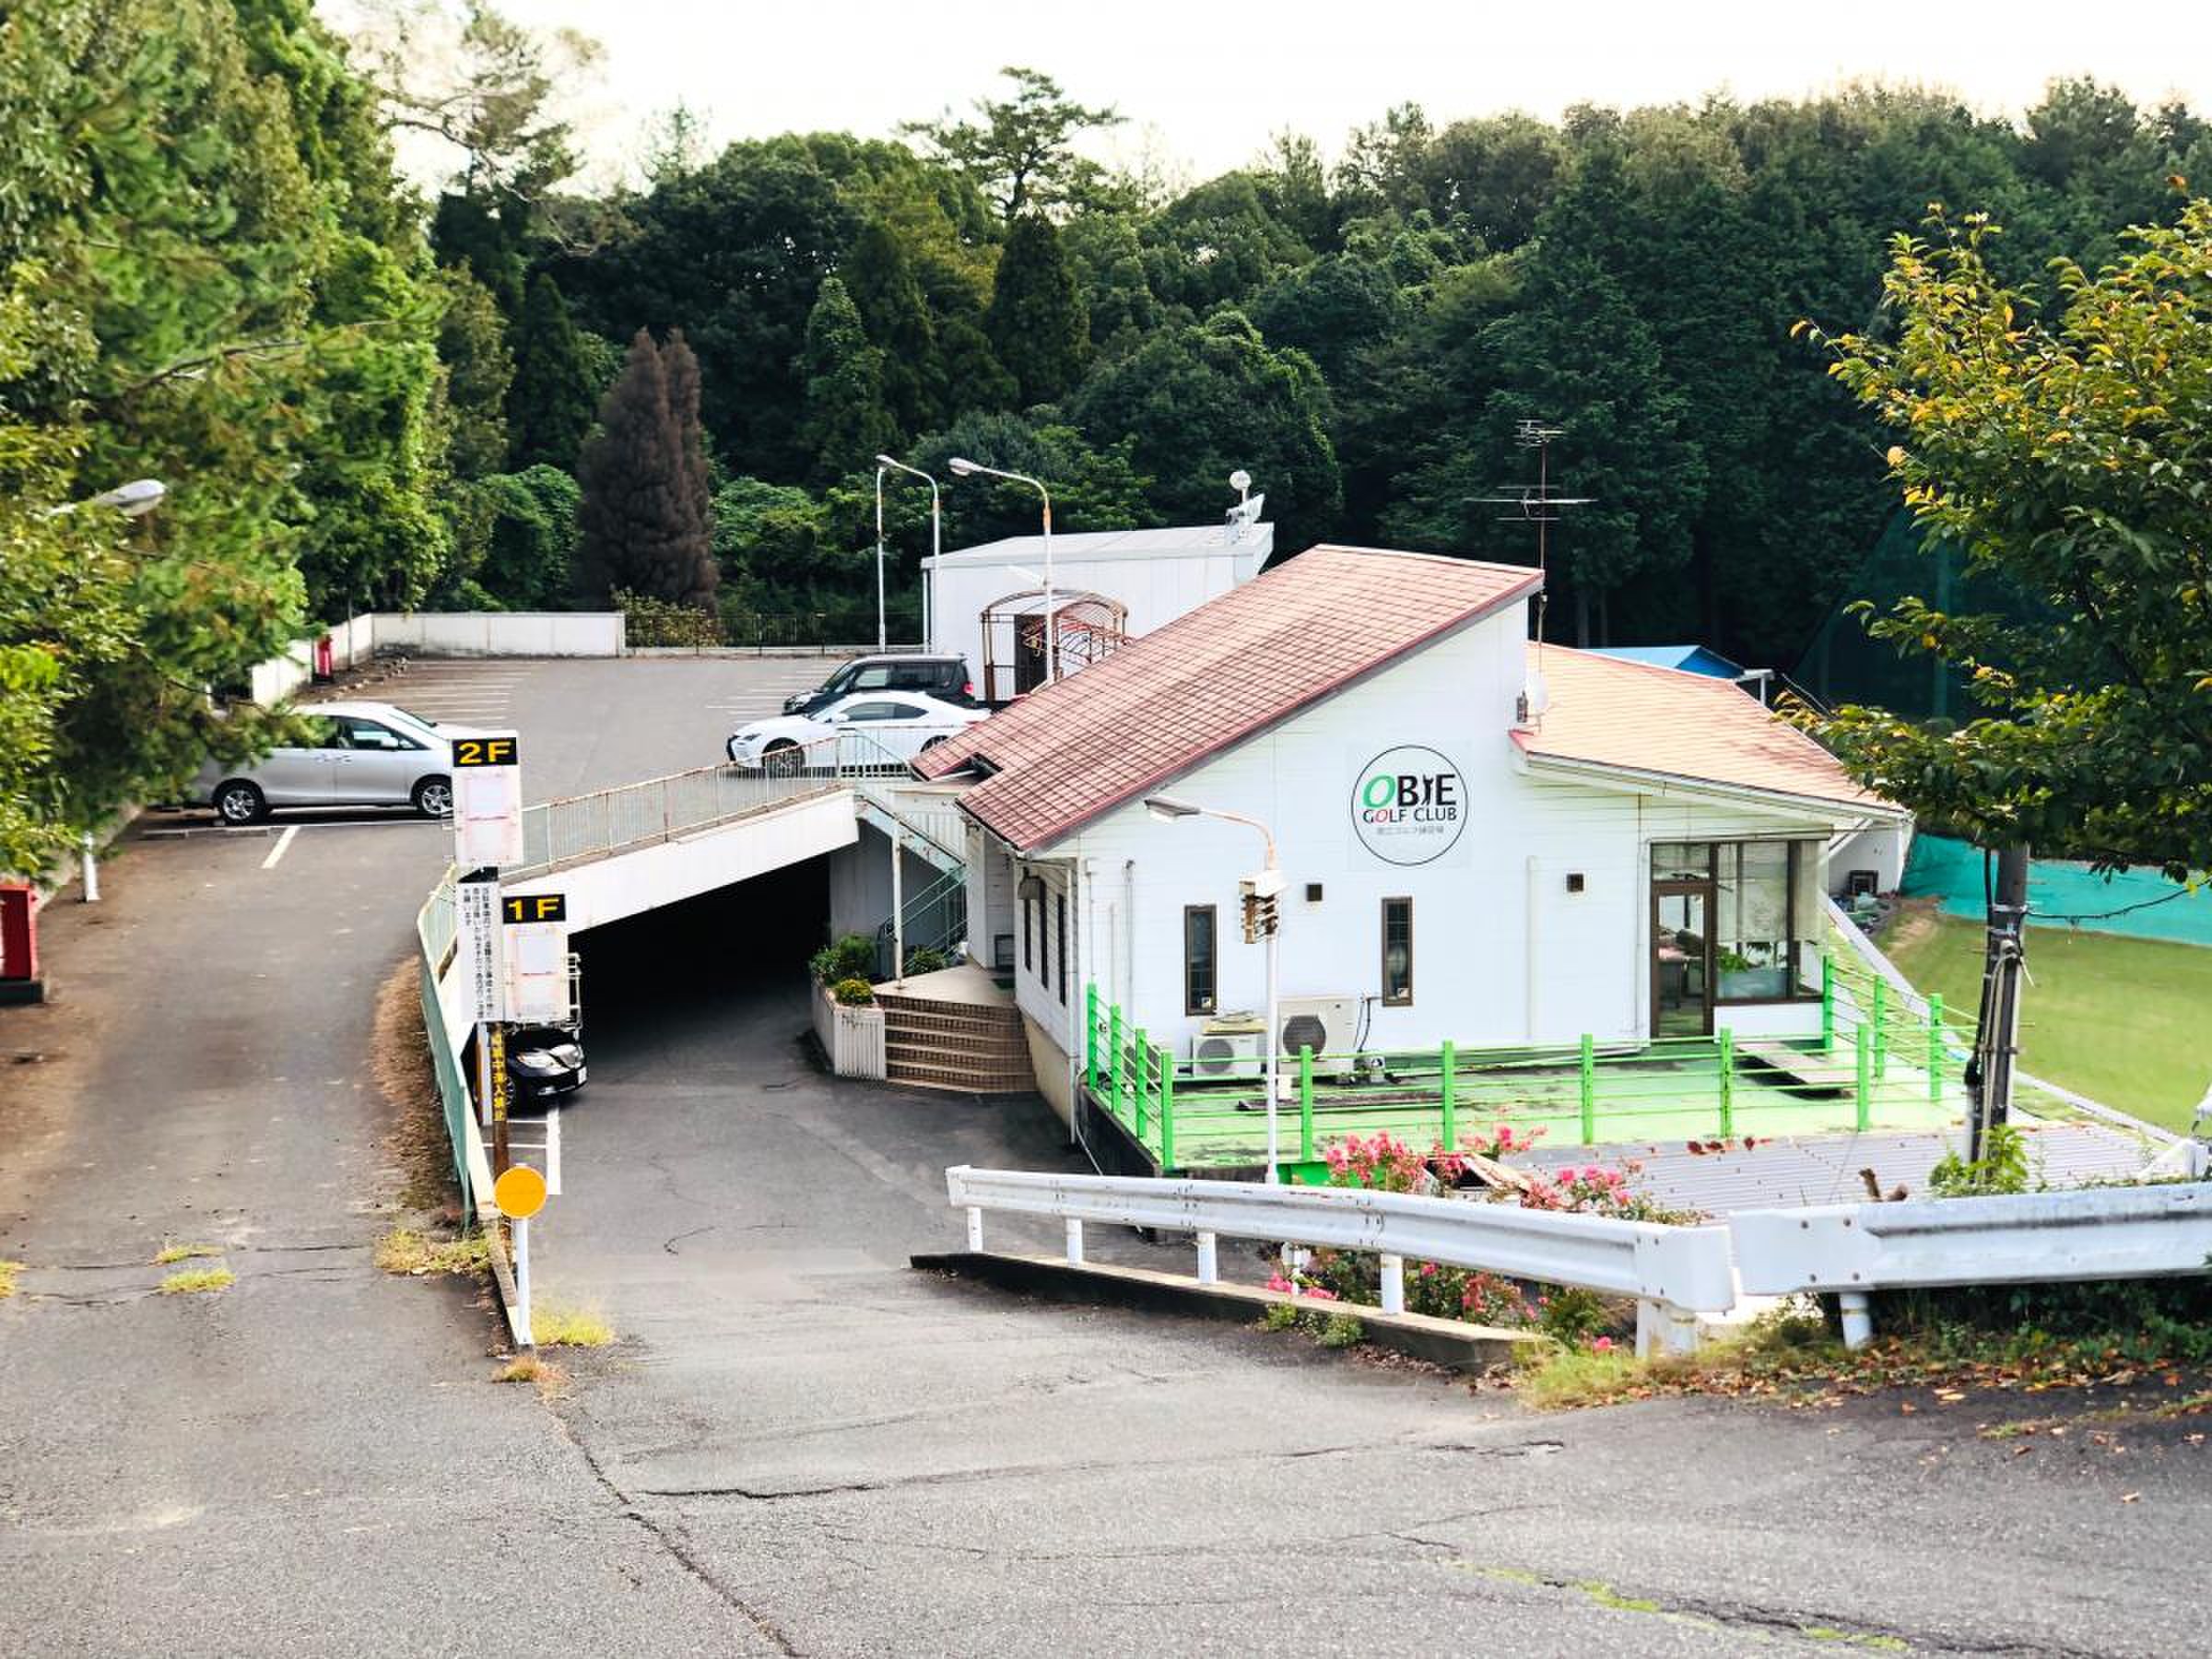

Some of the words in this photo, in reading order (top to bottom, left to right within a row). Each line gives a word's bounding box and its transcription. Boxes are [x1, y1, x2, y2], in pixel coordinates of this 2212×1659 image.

[459, 741, 512, 764] 2F
[1362, 808, 1407, 823] GOLF
[1413, 807, 1457, 822] CLUB
[508, 898, 560, 921] 1F
